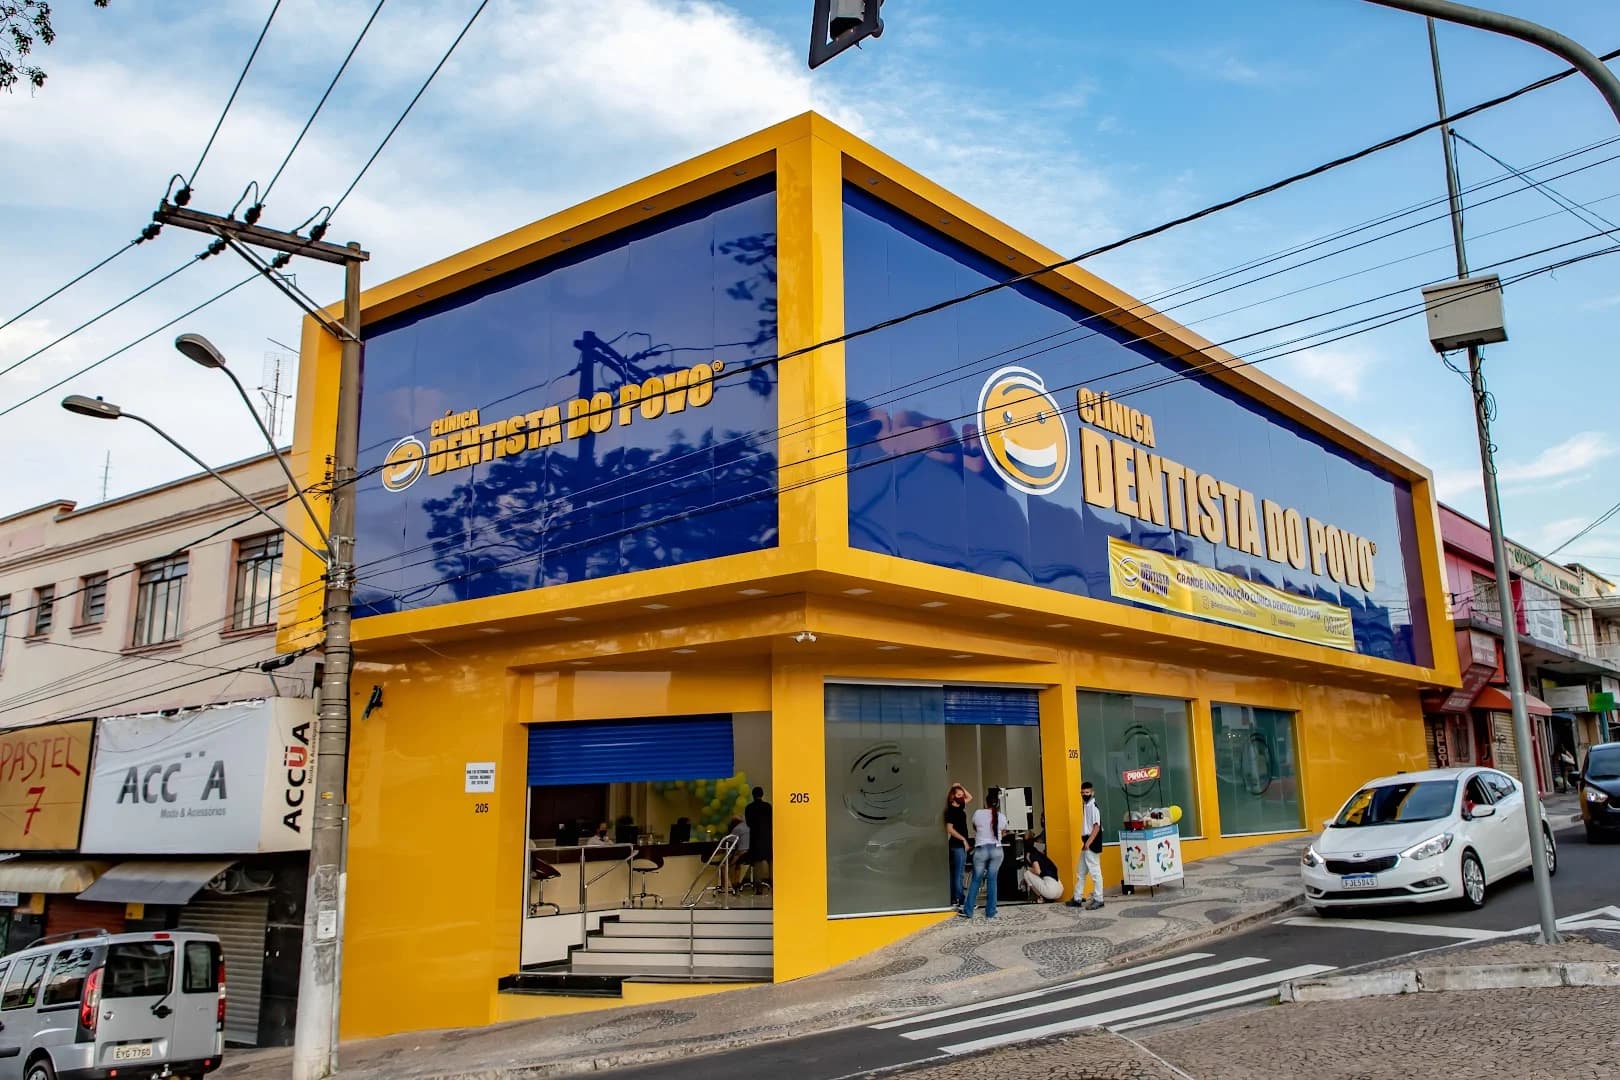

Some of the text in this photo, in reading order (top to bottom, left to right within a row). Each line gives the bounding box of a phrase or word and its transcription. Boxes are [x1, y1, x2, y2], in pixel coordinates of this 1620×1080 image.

[428, 405, 563, 476] DENTISTA
[567, 391, 613, 440] DO
[431, 409, 480, 437] CLÍNICA
[1076, 386, 1156, 449] CLÍNICA
[1078, 427, 1263, 558] DENTISTA
[1262, 498, 1306, 570] DO
[1176, 572, 1204, 589] GRANDE
[0, 737, 81, 782] PASTEL
[1068, 749, 1079, 759] 205
[24, 786, 46, 835] 7
[475, 803, 489, 814] 205
[790, 792, 810, 804] 205
